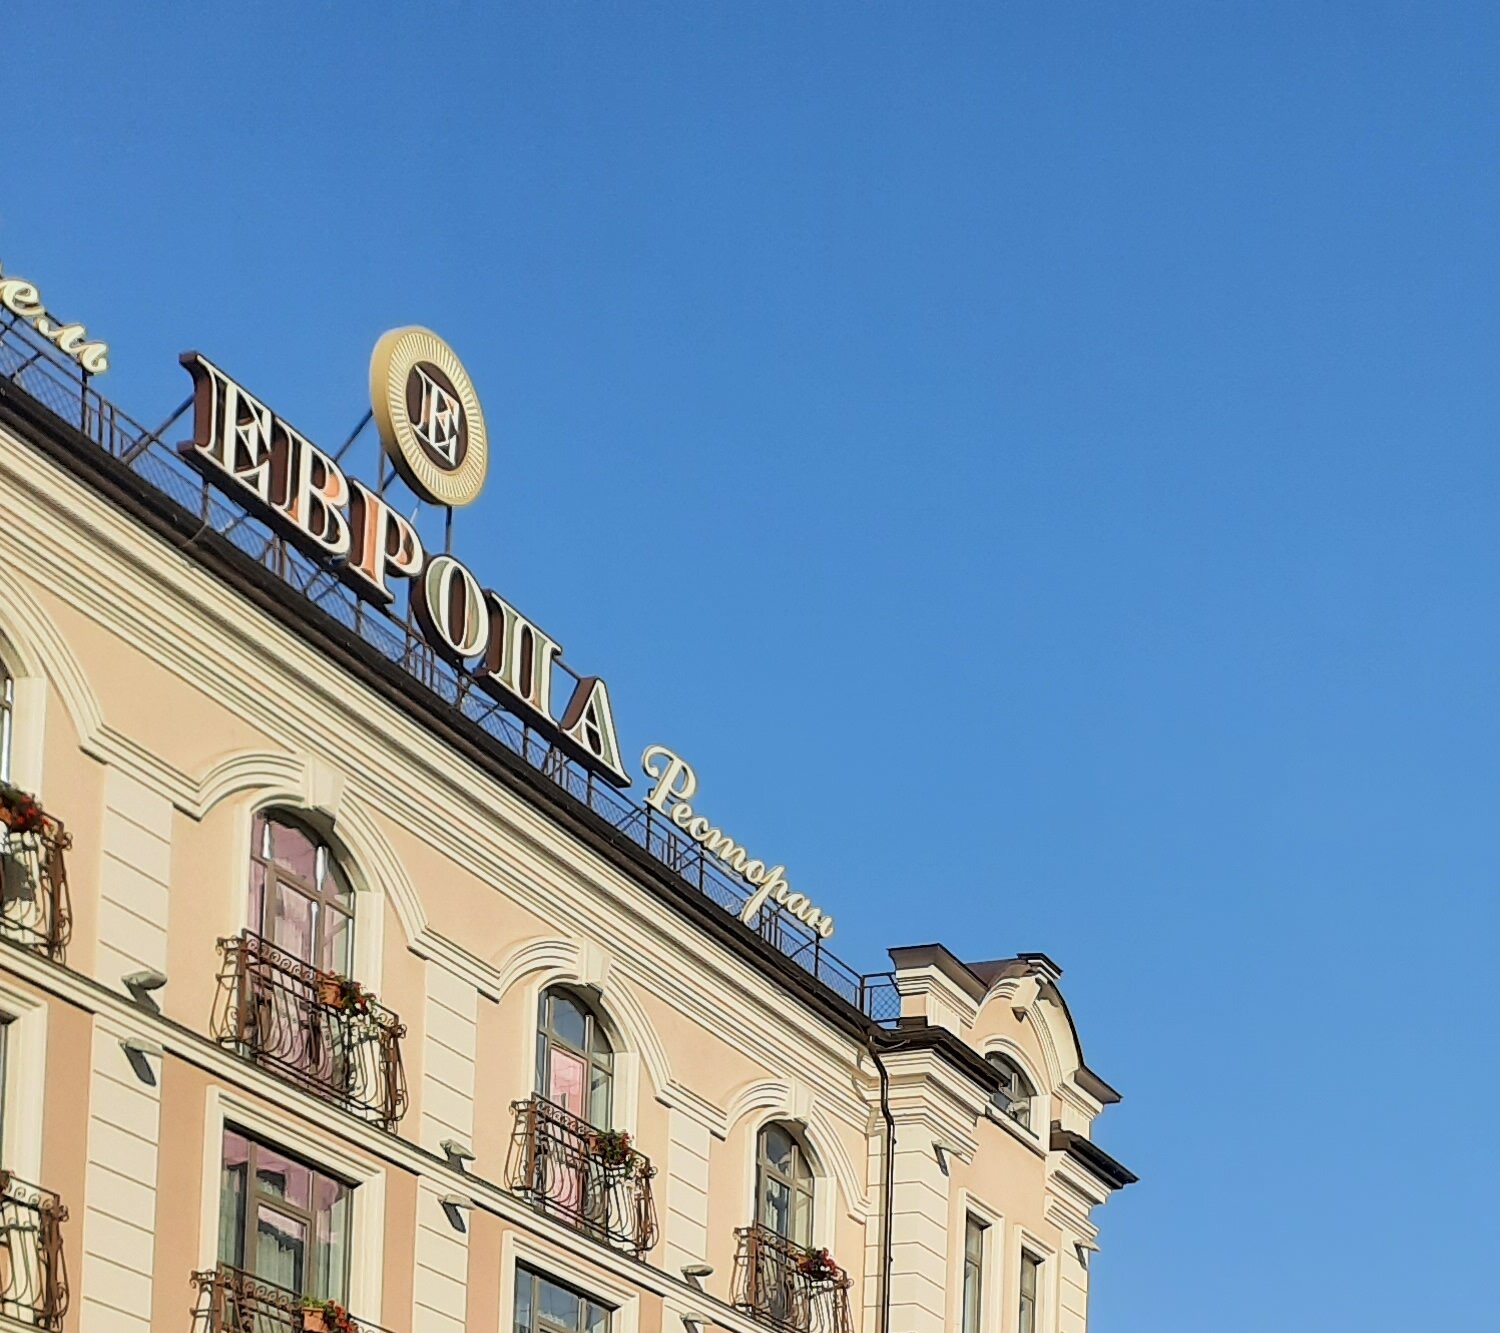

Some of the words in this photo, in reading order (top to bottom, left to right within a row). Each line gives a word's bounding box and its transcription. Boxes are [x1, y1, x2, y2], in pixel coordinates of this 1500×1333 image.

[0, 272, 109, 374] ель
[179, 351, 632, 788] ЕВРОПА
[641, 744, 834, 938] Ресторан
